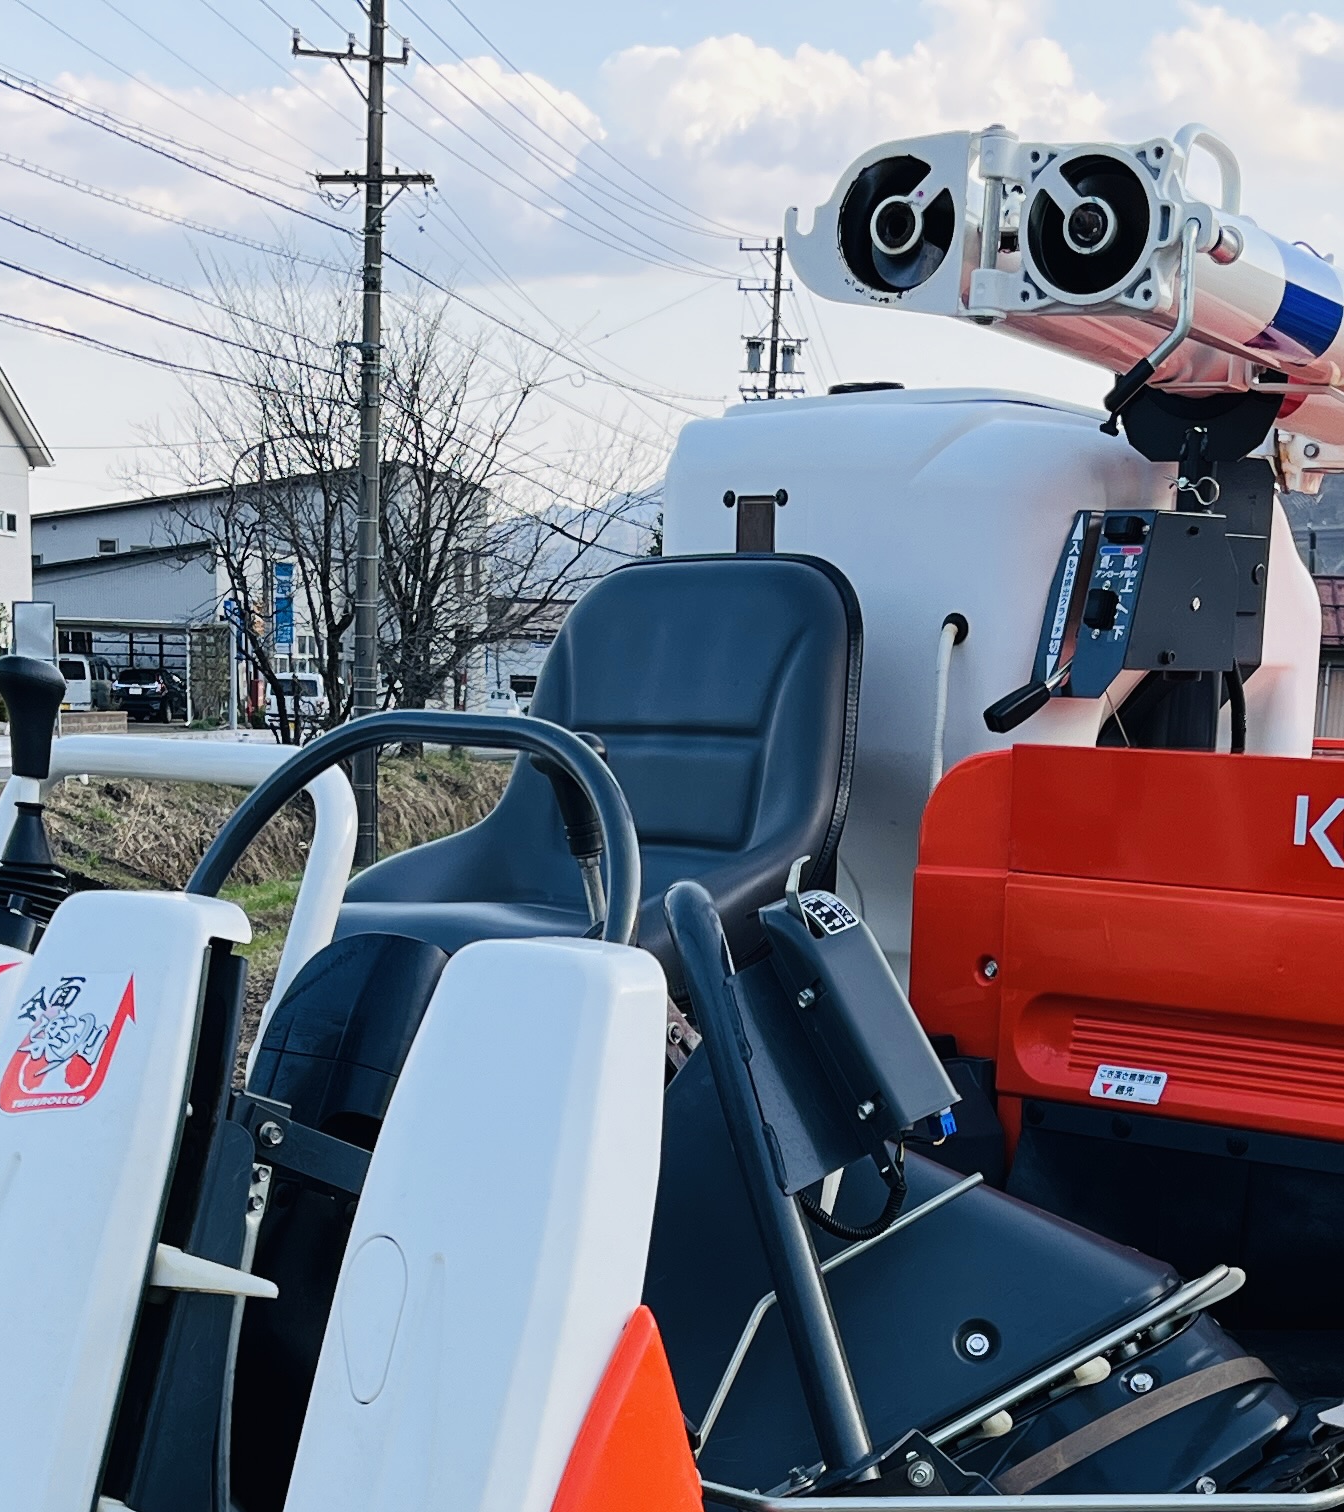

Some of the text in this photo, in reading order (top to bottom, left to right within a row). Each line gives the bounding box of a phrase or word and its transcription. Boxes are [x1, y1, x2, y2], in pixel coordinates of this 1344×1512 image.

[1068, 540, 1080, 555] 入
[1120, 577, 1134, 593] 上
[1113, 625, 1126, 640] 下
[1048, 639, 1061, 654] 切
[17, 976, 87, 1022] 全面
